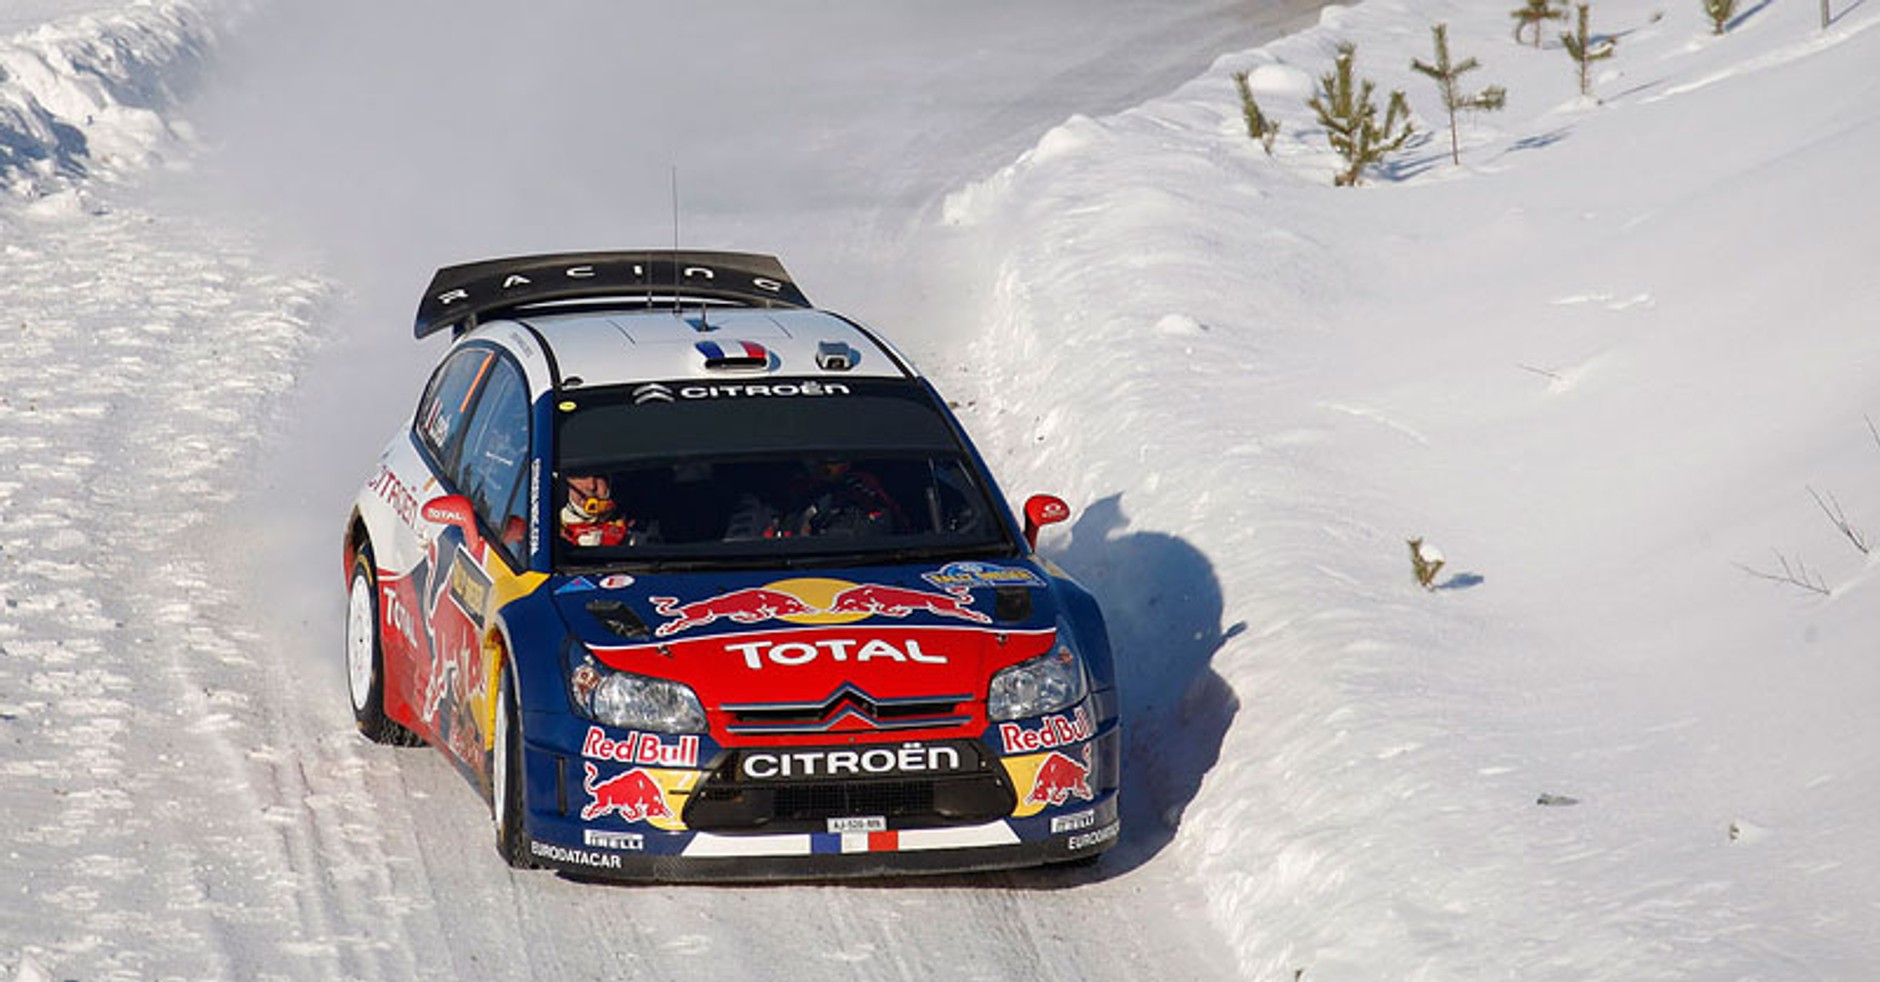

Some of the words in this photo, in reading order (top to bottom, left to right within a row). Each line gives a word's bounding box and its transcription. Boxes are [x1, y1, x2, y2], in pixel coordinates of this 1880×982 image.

[724, 639, 949, 670] TOTAL
[582, 726, 639, 762] Red
[636, 733, 698, 766] Bull
[1000, 717, 1058, 752] Red
[531, 841, 621, 868] EURODATACAR
[584, 829, 644, 850] PIRELLI
